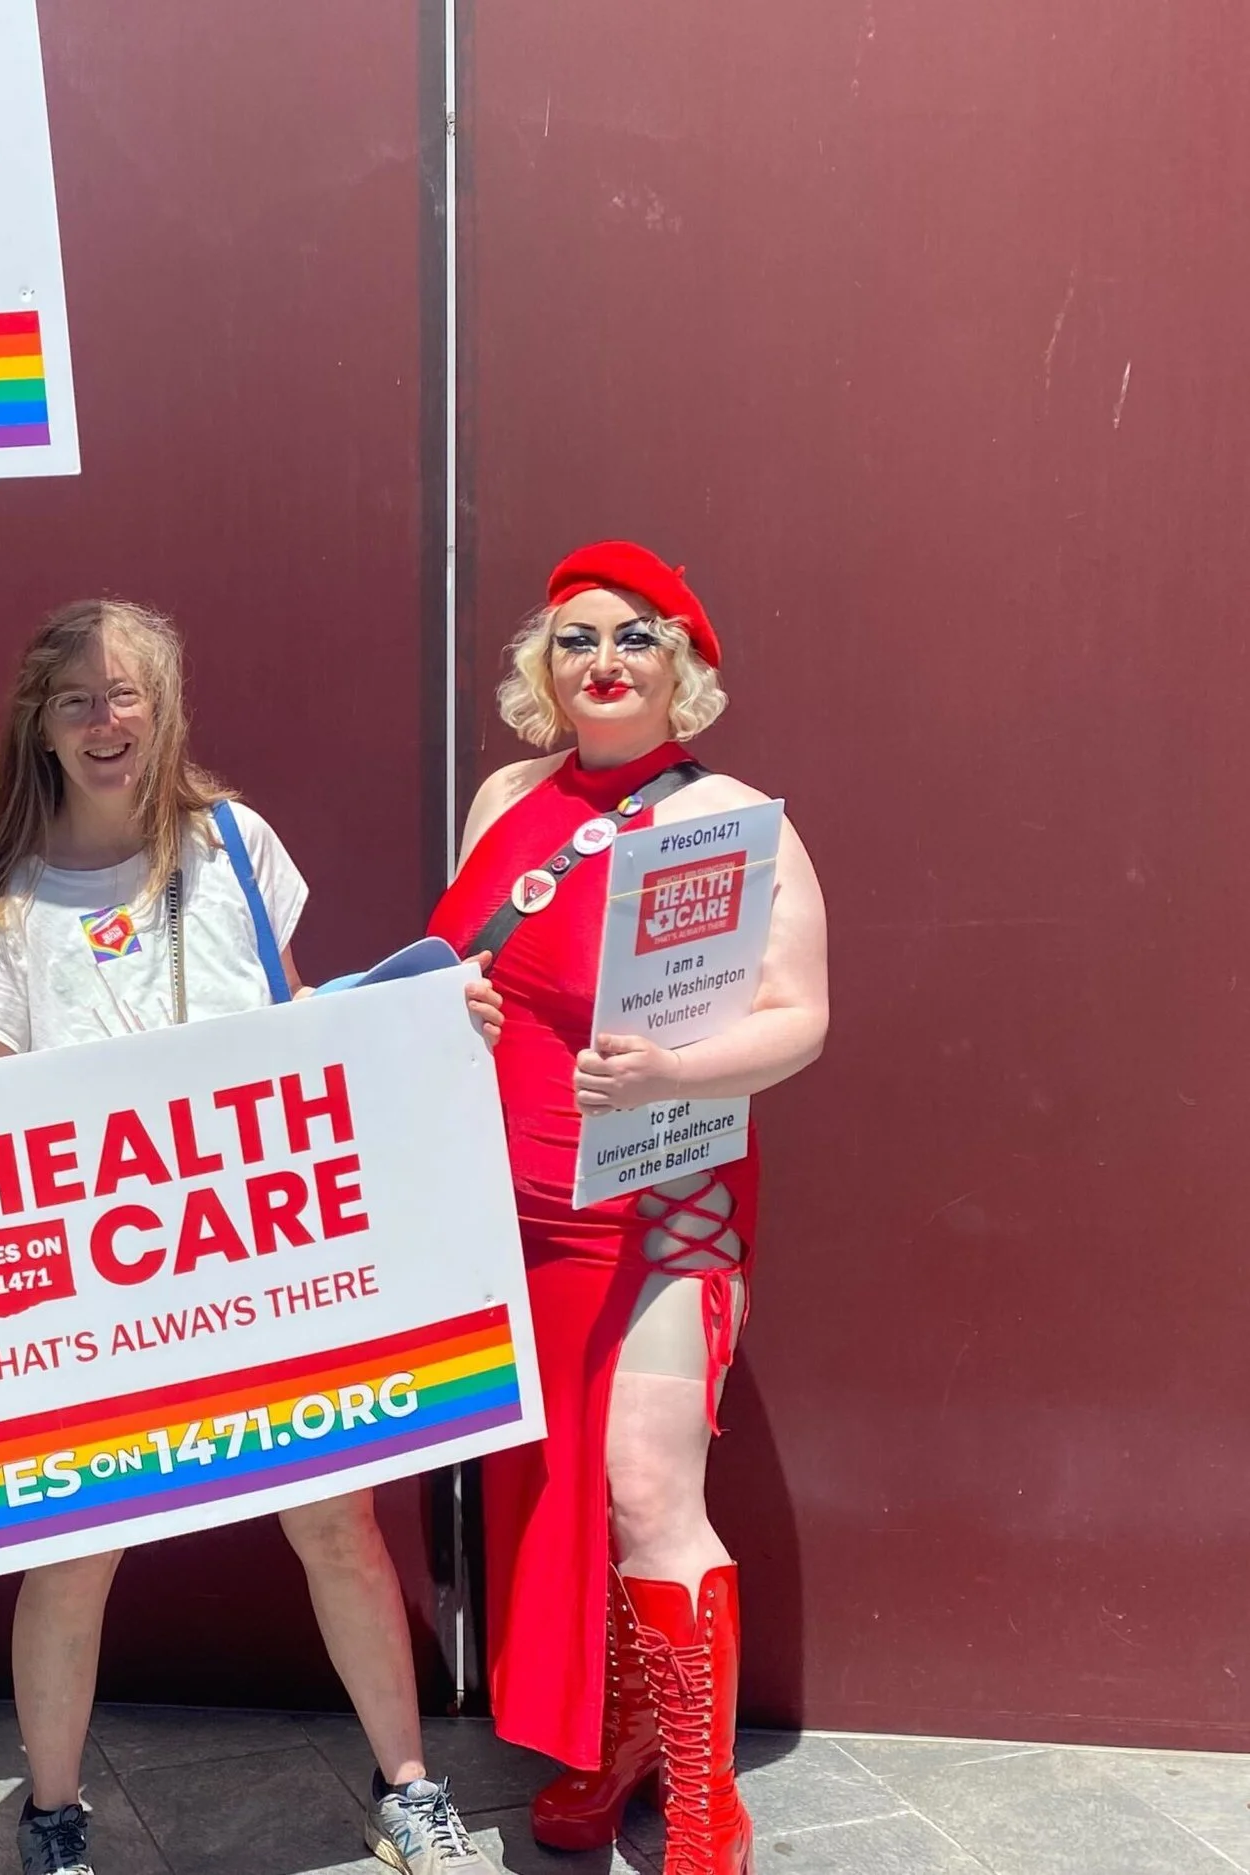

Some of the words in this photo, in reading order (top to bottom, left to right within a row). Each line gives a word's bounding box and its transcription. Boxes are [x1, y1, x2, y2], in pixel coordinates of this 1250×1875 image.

[660, 821, 740, 853] #YesOn1471
[654, 870, 734, 911] HEALTH
[676, 895, 731, 928] CARE
[665, 960, 670, 976] I
[673, 957, 693, 974] am
[696, 955, 704, 967] a
[621, 989, 664, 1013] Whole
[668, 967, 746, 1000] Washington
[647, 1001, 712, 1030] Volunteer
[650, 1111, 665, 1126] to
[668, 1101, 690, 1123] get
[597, 1133, 660, 1166] Universal
[663, 1114, 735, 1146] Healthcare
[618, 1167, 636, 1183] on
[640, 1158, 662, 1177] the
[665, 1142, 710, 1169] Ballot!
[89, 1152, 370, 1287] CARE
[27, 1236, 64, 1259] ON
[111, 1297, 259, 1356] ALWAYS
[264, 1264, 381, 1319] THERE
[89, 1443, 144, 1482] ON
[147, 1370, 421, 1477] 1471.ORG
